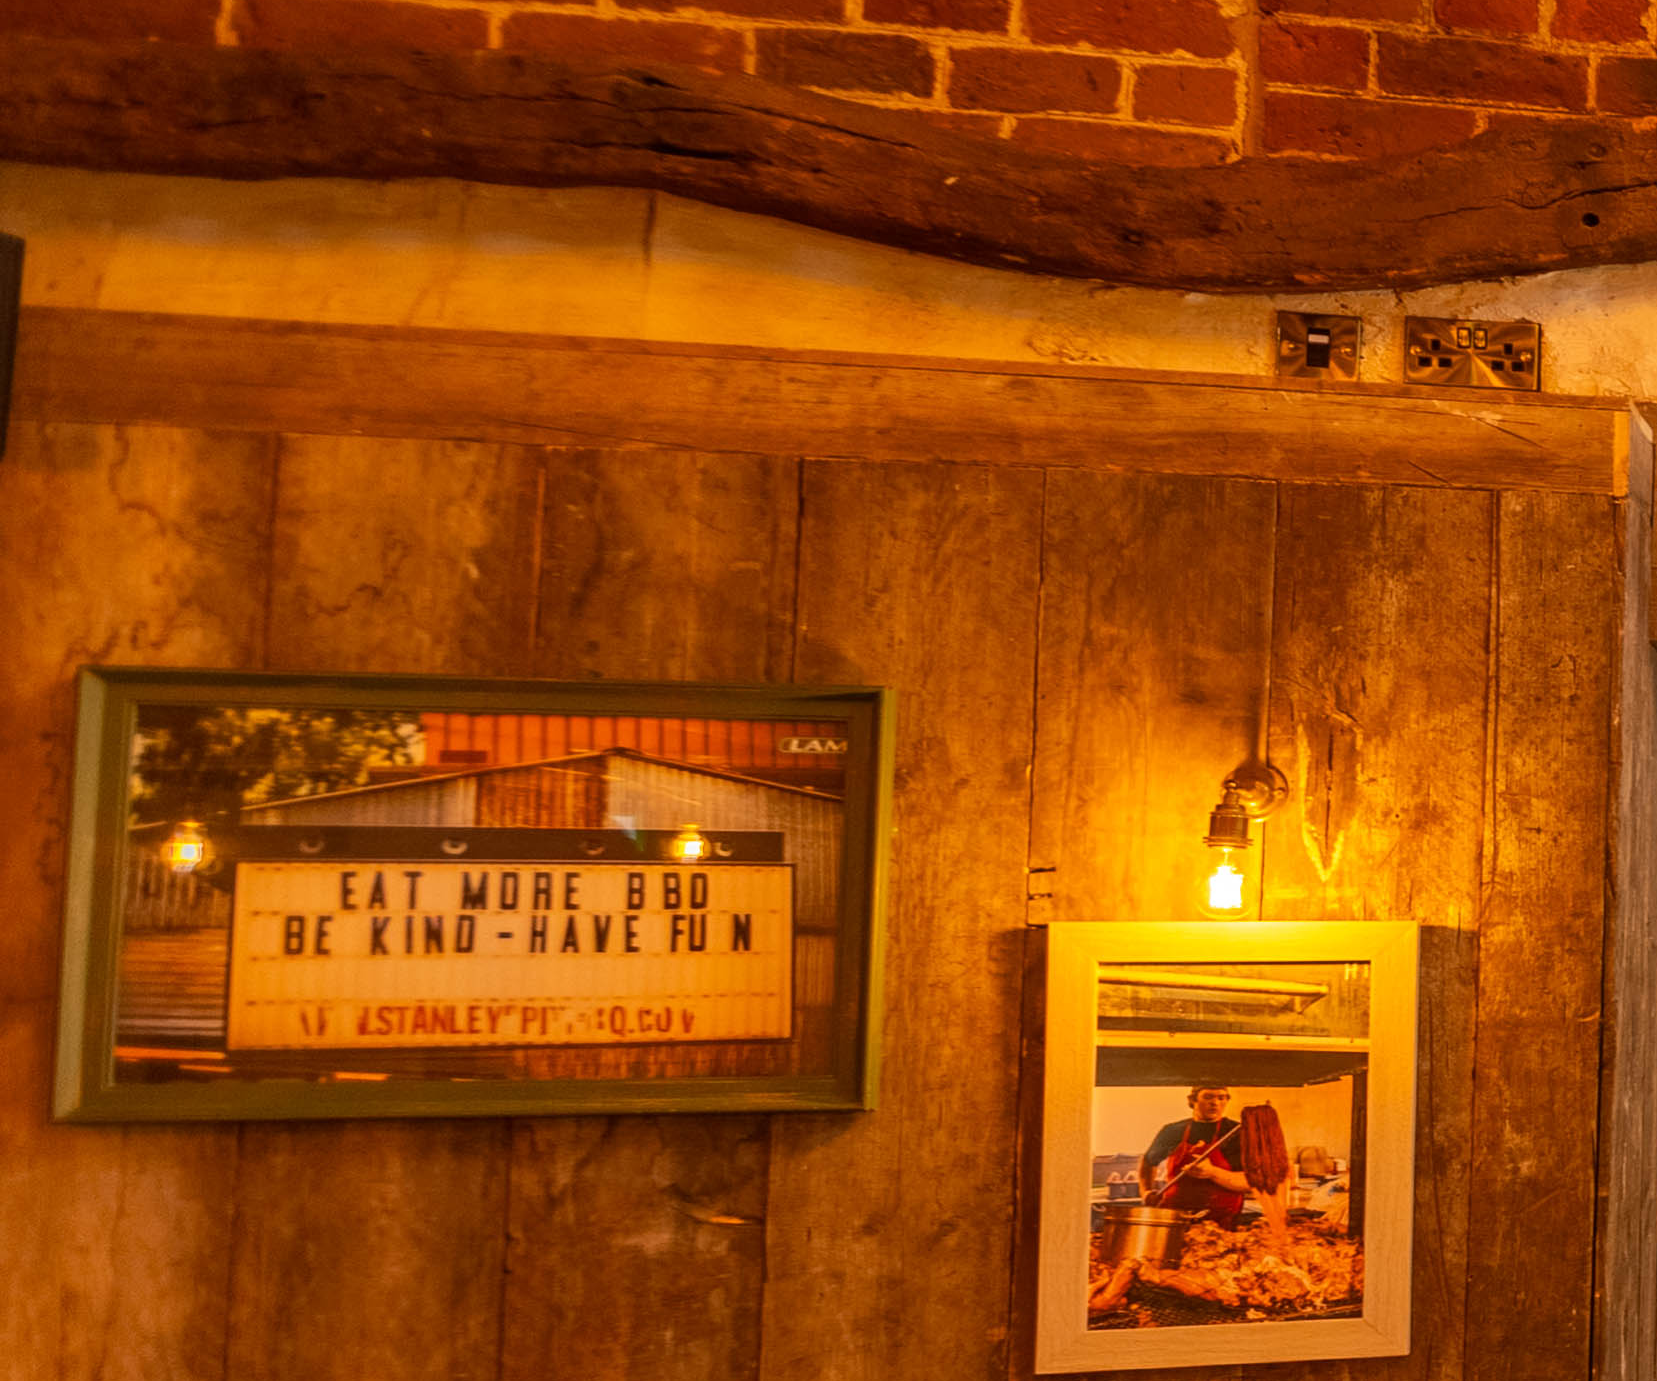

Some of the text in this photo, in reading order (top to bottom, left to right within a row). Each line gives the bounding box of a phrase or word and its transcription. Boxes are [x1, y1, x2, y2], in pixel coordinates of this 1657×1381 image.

[341, 871, 423, 910] EAT
[461, 872, 581, 910] MORE
[284, 915, 332, 955] BE
